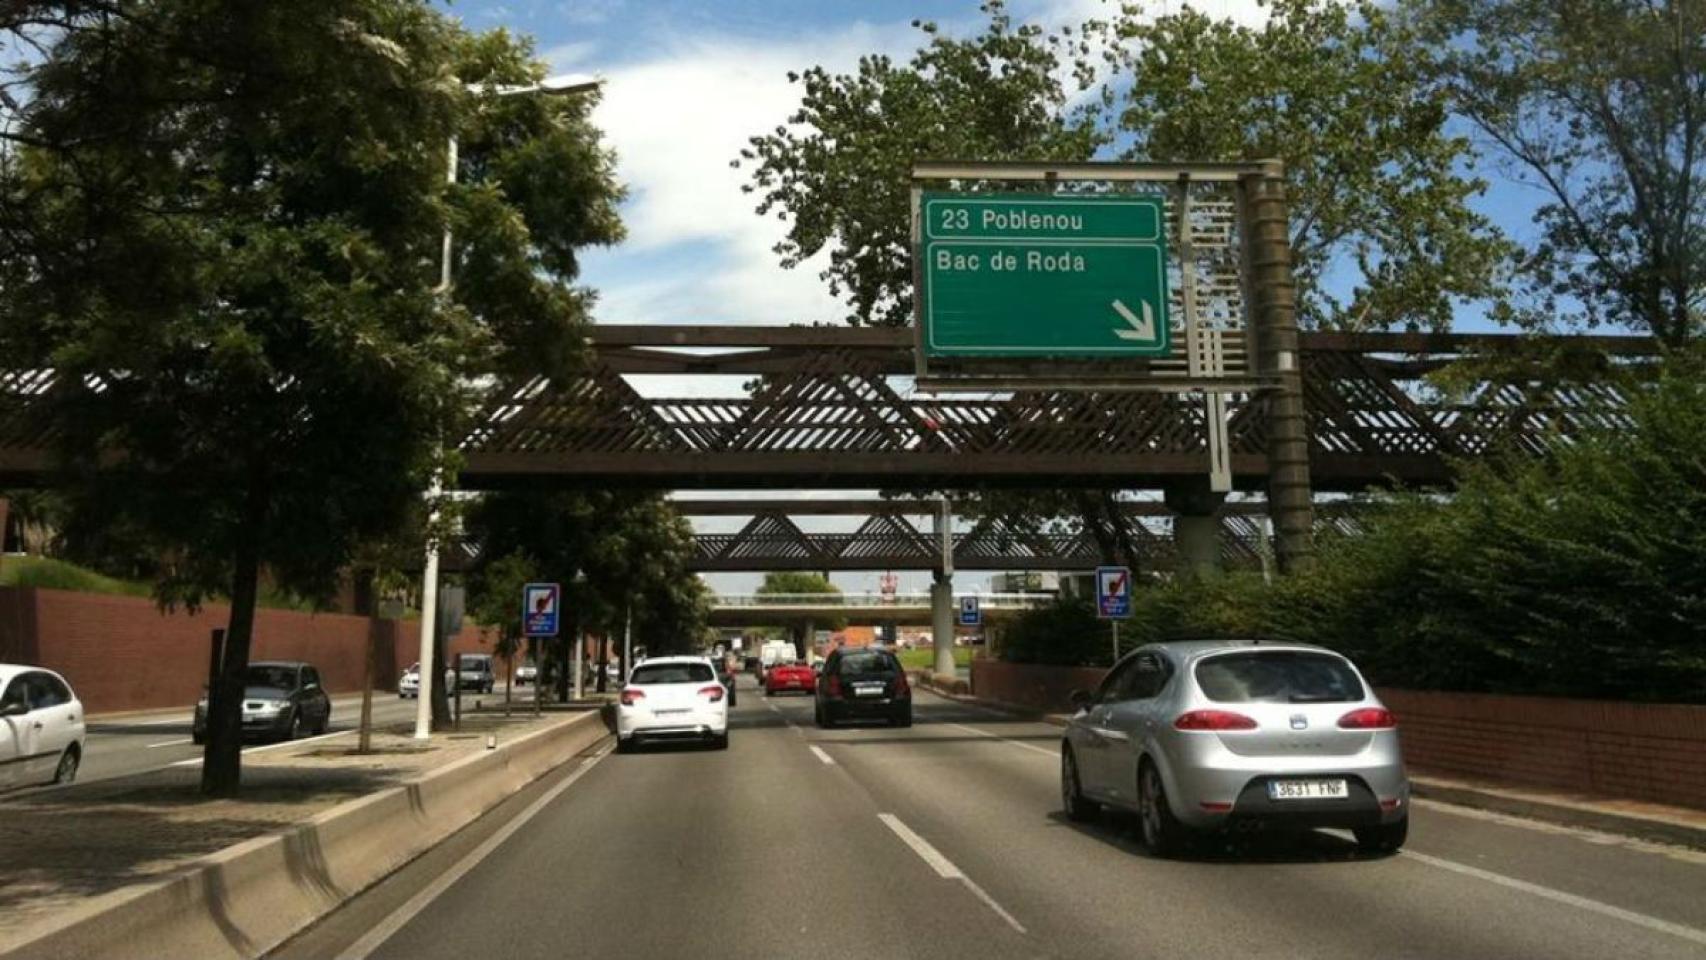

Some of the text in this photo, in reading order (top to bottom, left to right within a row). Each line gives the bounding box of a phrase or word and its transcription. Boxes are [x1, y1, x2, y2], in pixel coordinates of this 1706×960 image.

[941, 209, 1083, 230] 23 Poblenou
[937, 250, 1086, 272] Bac de Roda
